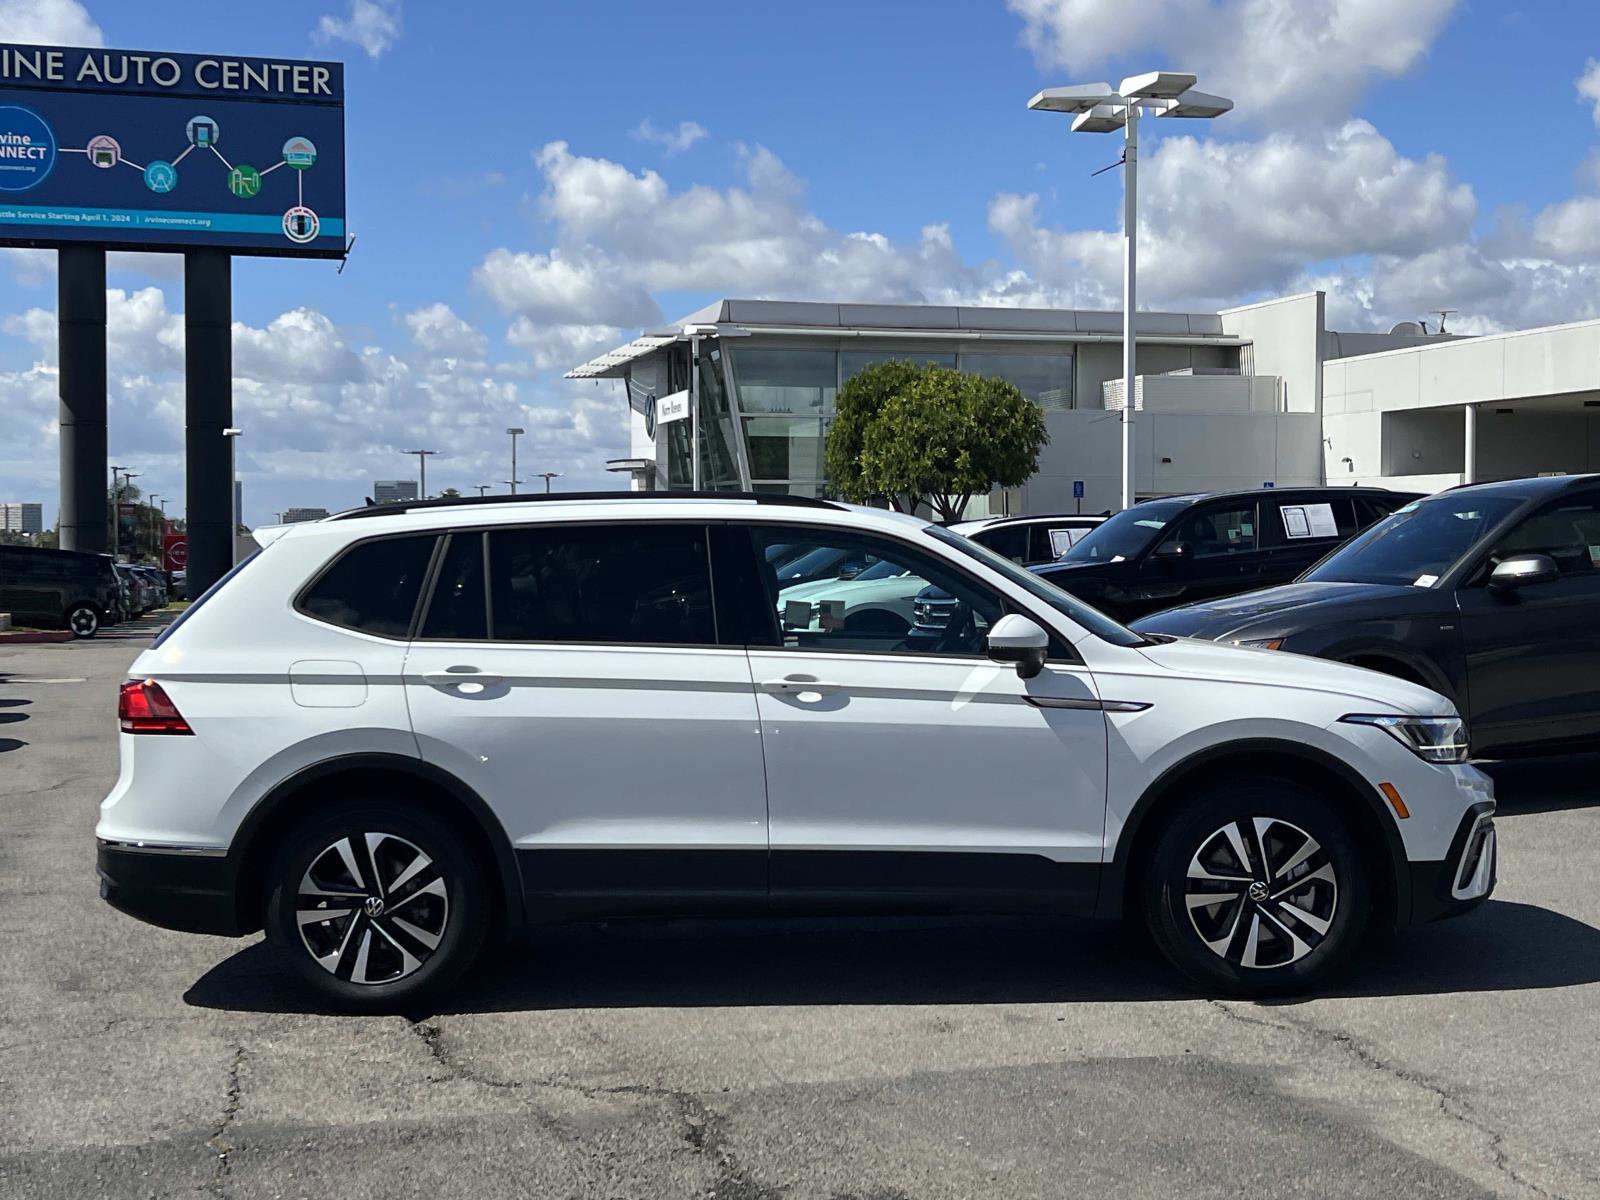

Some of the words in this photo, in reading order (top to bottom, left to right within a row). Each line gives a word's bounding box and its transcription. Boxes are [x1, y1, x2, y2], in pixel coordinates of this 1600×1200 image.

[2, 49, 64, 80] INE
[76, 53, 181, 87] AUTO
[194, 59, 333, 95] CENTER
[0, 131, 31, 145] vine
[47, 212, 80, 222] Starting
[80, 213, 101, 222] April
[111, 214, 131, 222] 2024
